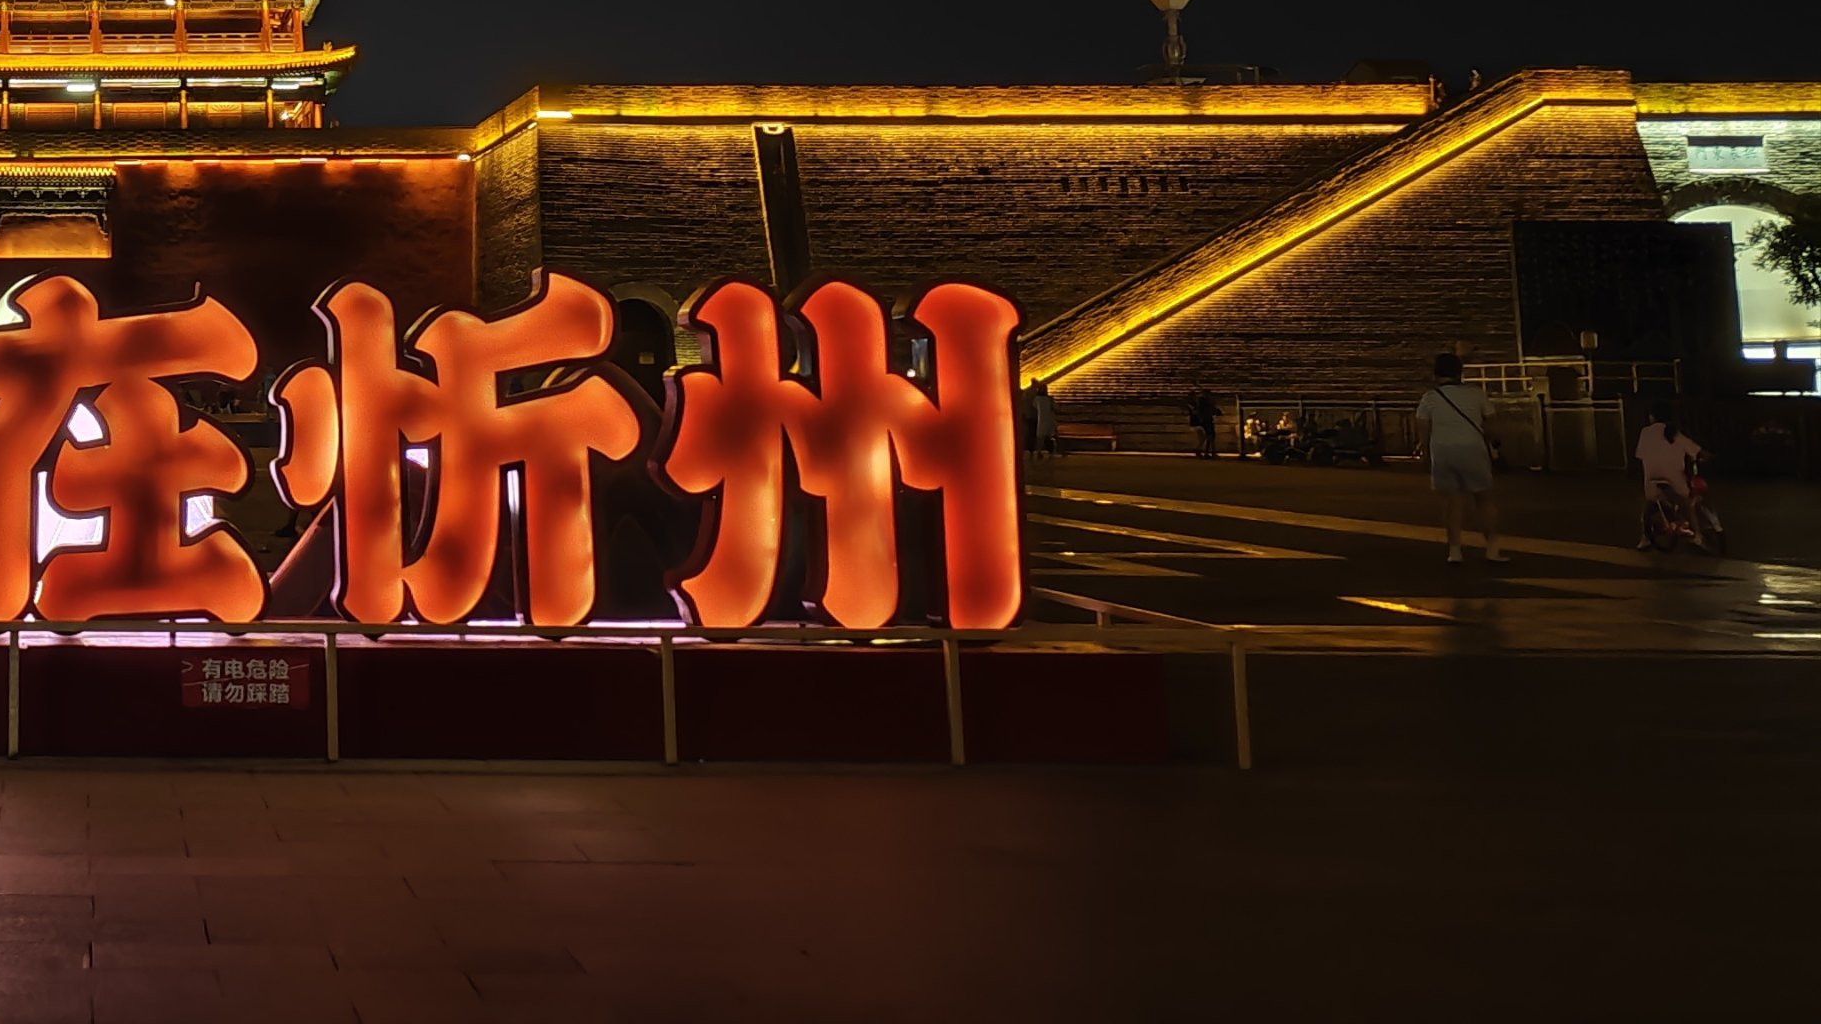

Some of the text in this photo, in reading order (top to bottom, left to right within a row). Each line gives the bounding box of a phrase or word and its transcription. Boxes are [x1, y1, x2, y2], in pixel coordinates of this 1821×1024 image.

[201, 658, 290, 680] 有电危险
[201, 682, 290, 704] 请勿踩踏
